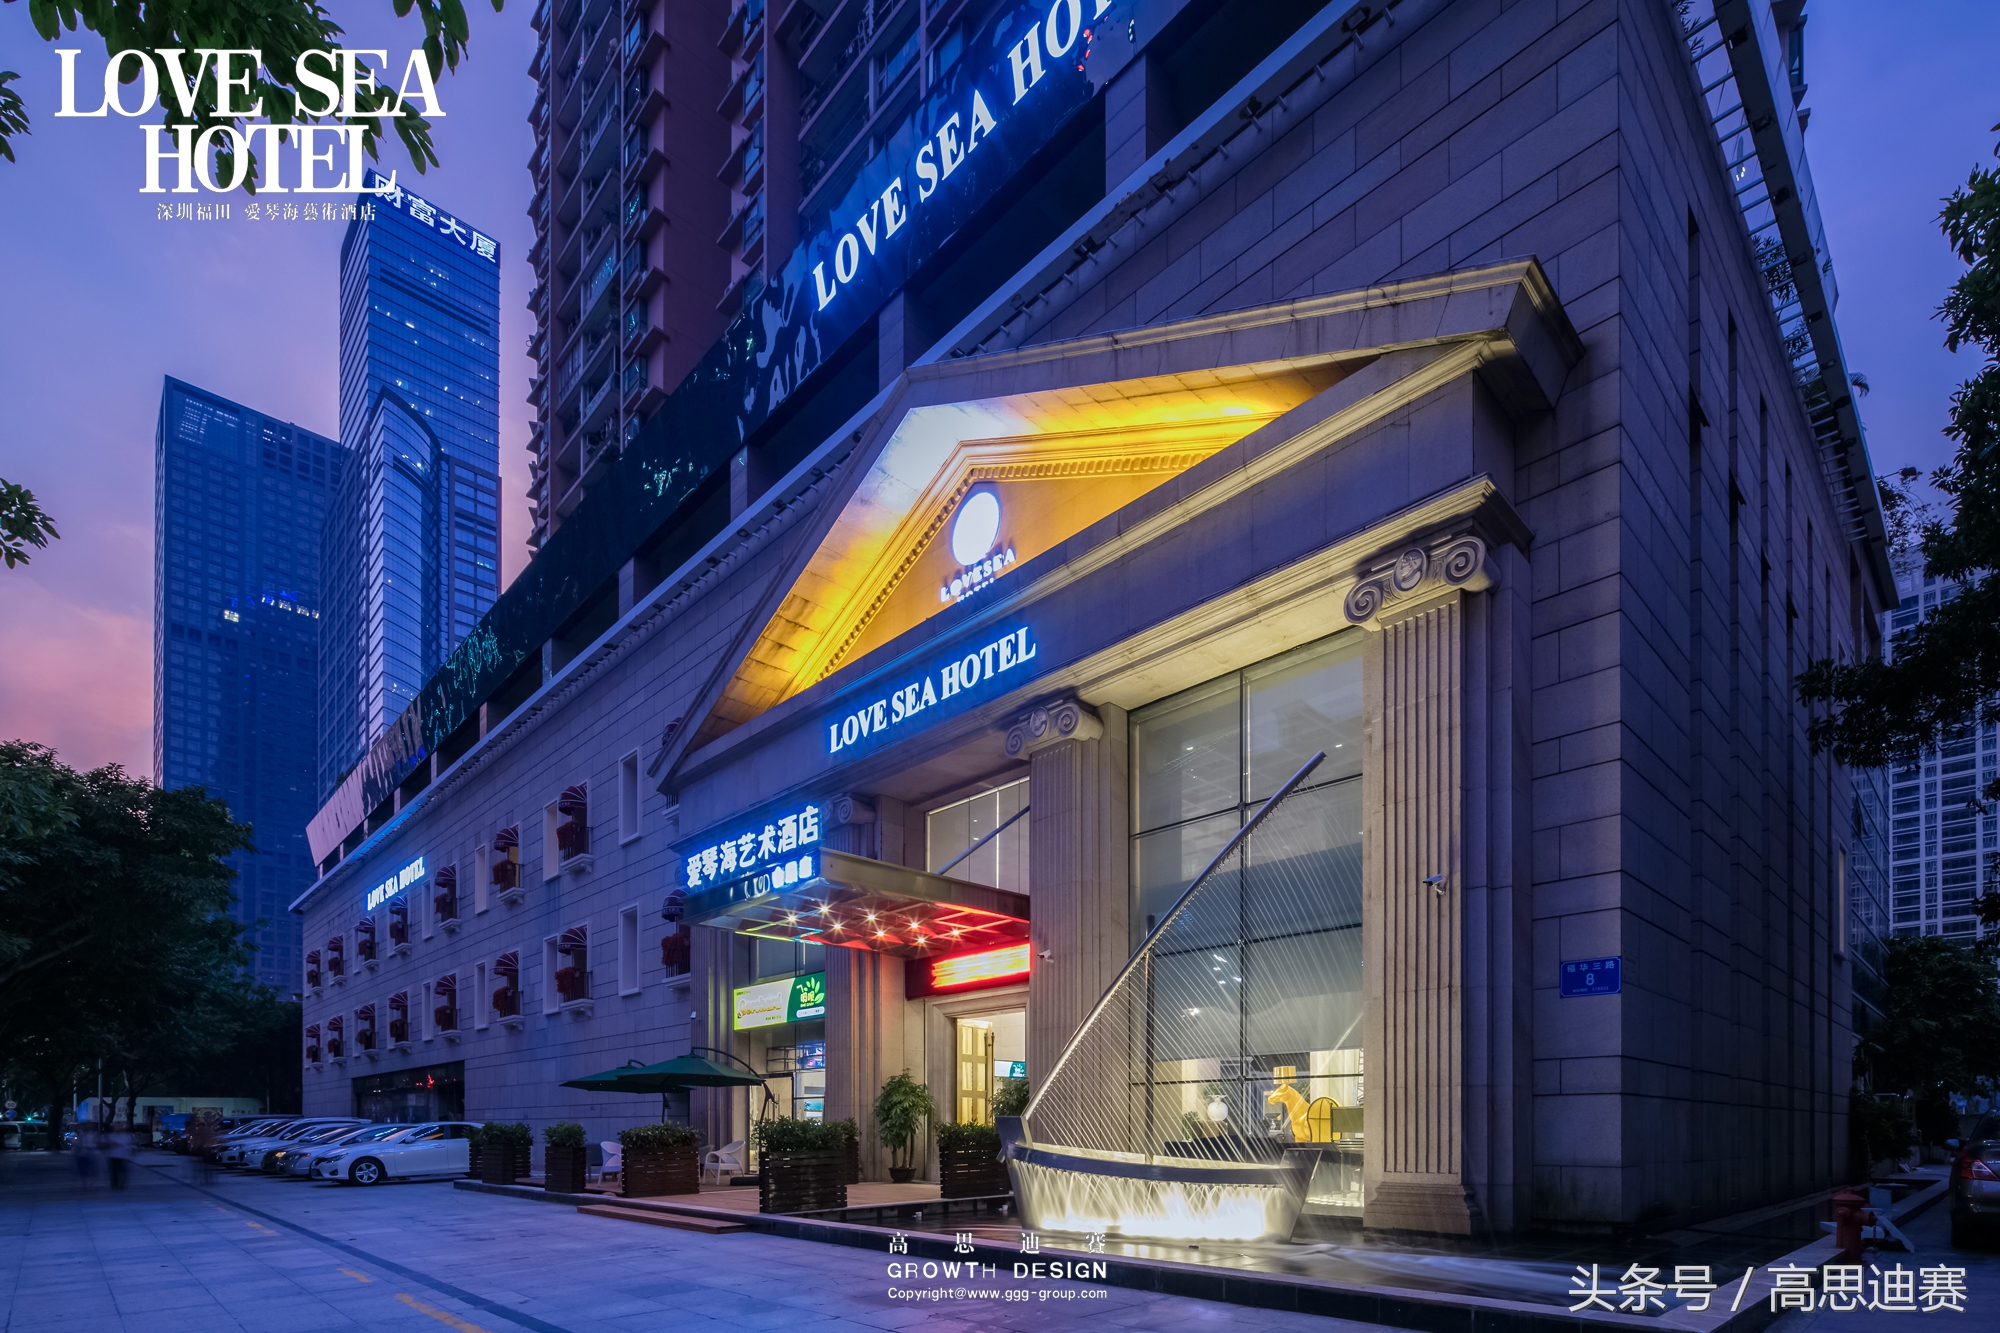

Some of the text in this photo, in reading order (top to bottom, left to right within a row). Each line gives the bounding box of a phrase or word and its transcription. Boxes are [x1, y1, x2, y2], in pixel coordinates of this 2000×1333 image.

[811, 0, 1112, 312] LOVE SEA HO
[375, 173, 497, 263] 财富大厦
[829, 625, 1037, 754] LOVE SEA HOTEL
[367, 856, 425, 911] LOVE SEA HOTEL
[686, 805, 819, 888] 爱琴海艺术酒店
[1585, 973, 1595, 986] 8
